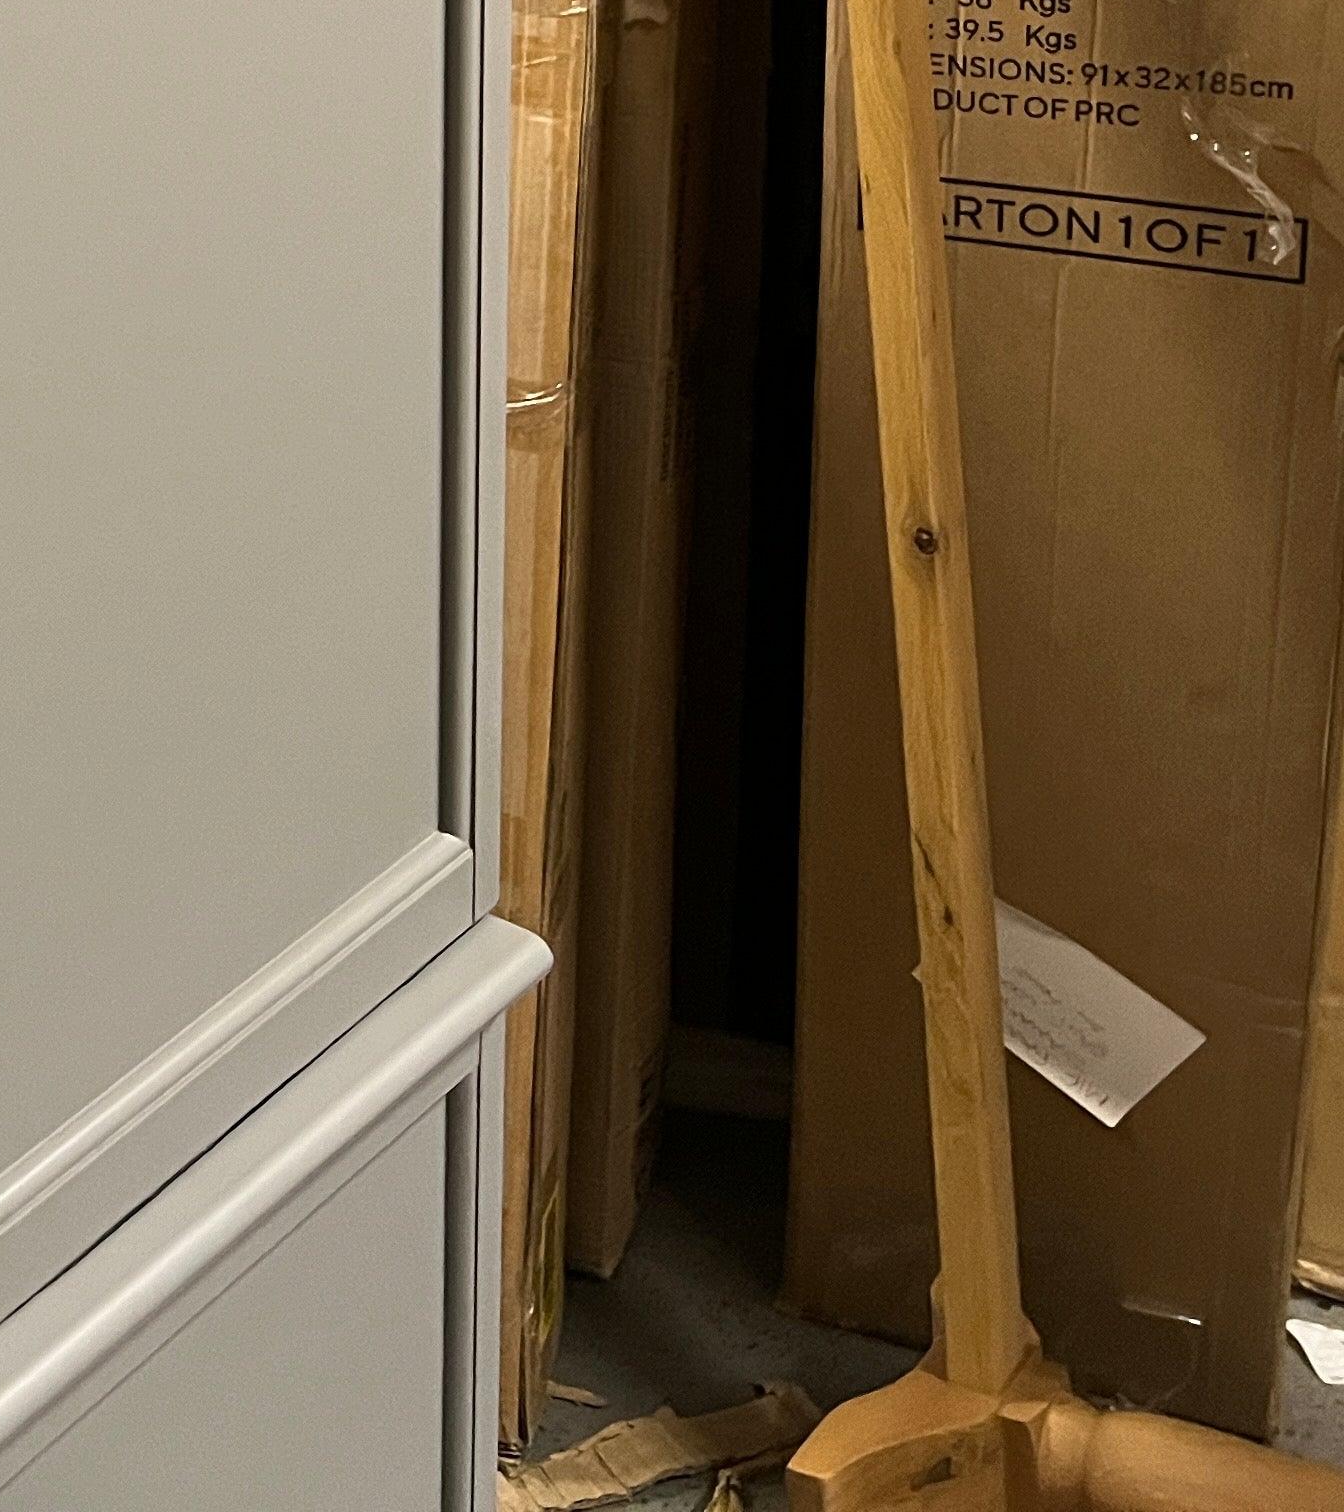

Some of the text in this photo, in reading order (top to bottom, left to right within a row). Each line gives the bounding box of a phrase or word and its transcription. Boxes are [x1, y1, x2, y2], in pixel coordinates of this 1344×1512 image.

[945, 17, 1005, 42] 39.5
[1025, 24, 1078, 54] Kgs
[933, 88, 1141, 127] DUCT OF PRC
[942, 194, 1258, 263] RTON 1 OF 1
